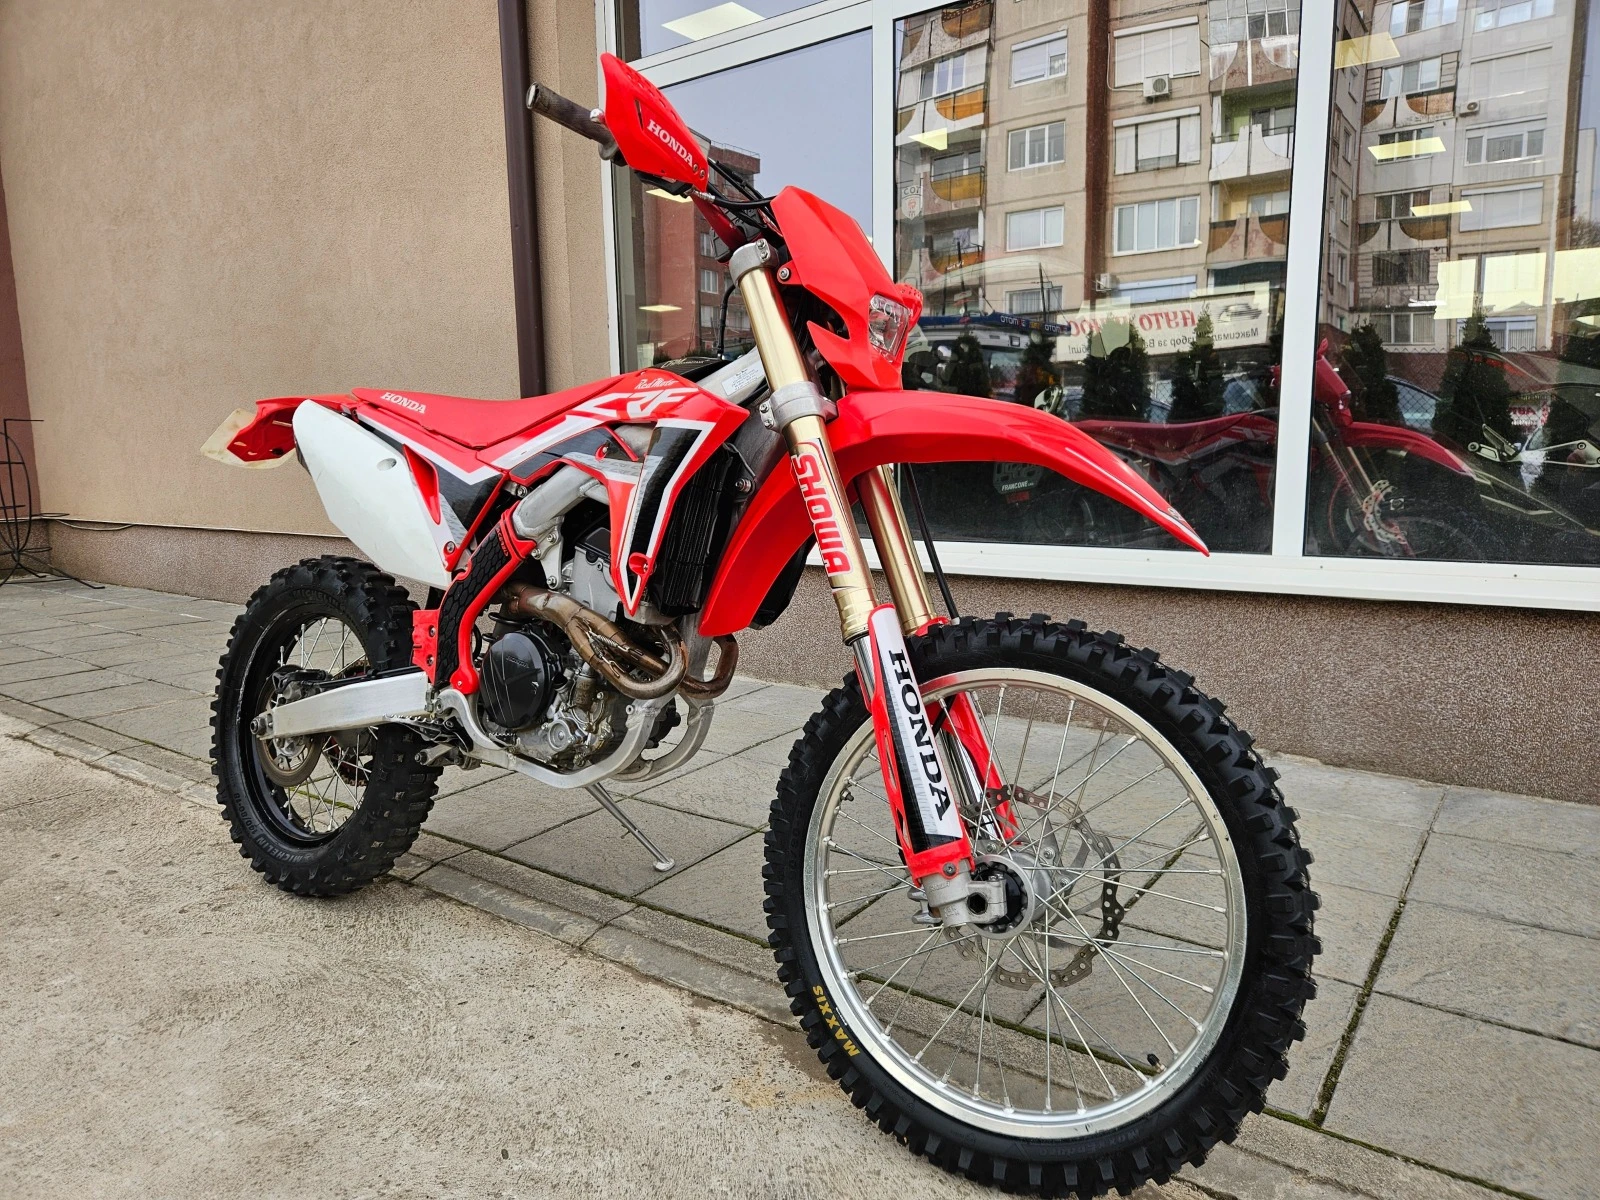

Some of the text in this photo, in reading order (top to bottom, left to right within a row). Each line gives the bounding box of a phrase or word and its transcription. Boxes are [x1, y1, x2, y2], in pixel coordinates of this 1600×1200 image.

[646, 119, 693, 168] HONDA
[380, 391, 426, 414] HONDA
[571, 387, 700, 420] CRF
[792, 453, 852, 576] SHOWA
[888, 649, 951, 821] HONDA
[256, 834, 304, 863] MICHELIN
[812, 985, 861, 1057] MAXXIS
